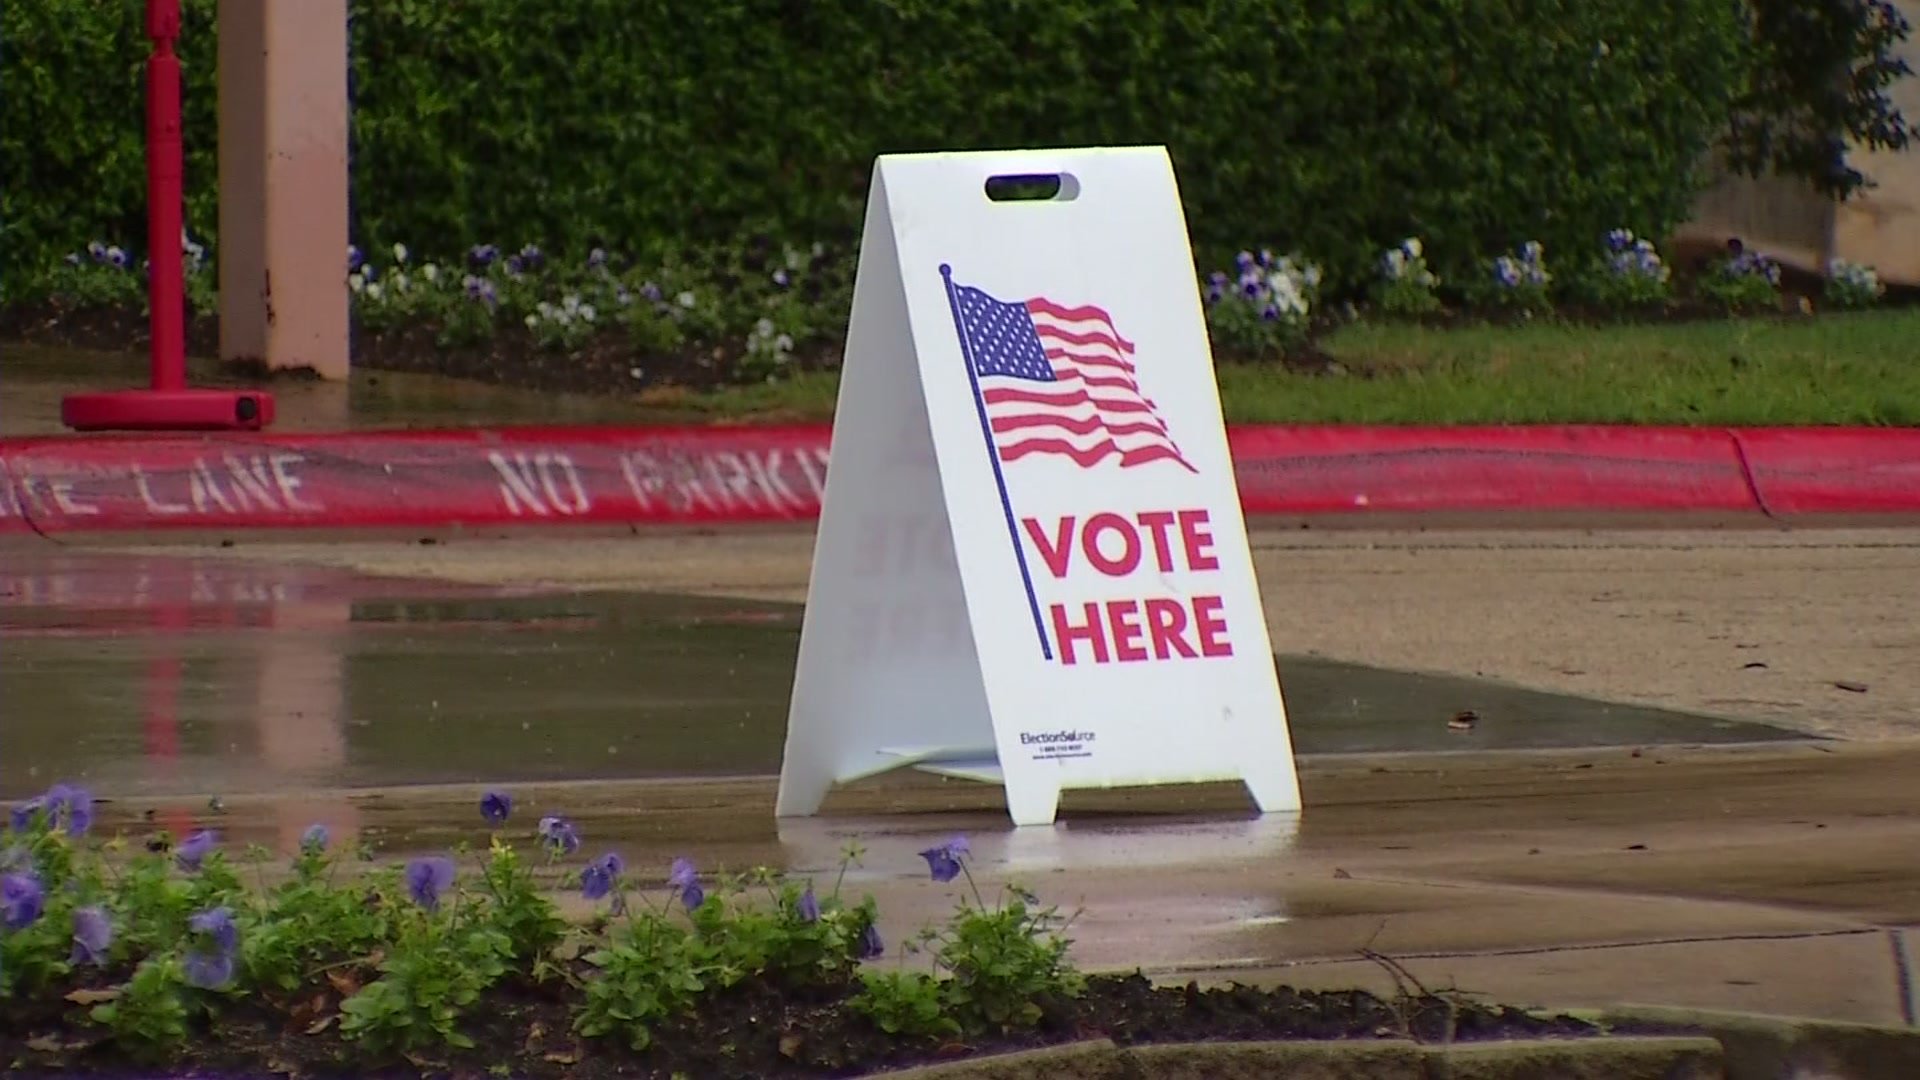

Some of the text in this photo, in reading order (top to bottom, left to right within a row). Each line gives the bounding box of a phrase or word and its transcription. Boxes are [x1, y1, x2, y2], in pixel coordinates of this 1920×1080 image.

[131, 453, 325, 513] LANE
[488, 453, 590, 516] NO
[620, 448, 829, 515] PARKI
[1021, 509, 1220, 578] VOTE
[1050, 595, 1234, 665] HERE
[1020, 730, 1096, 744] ElectionSource
